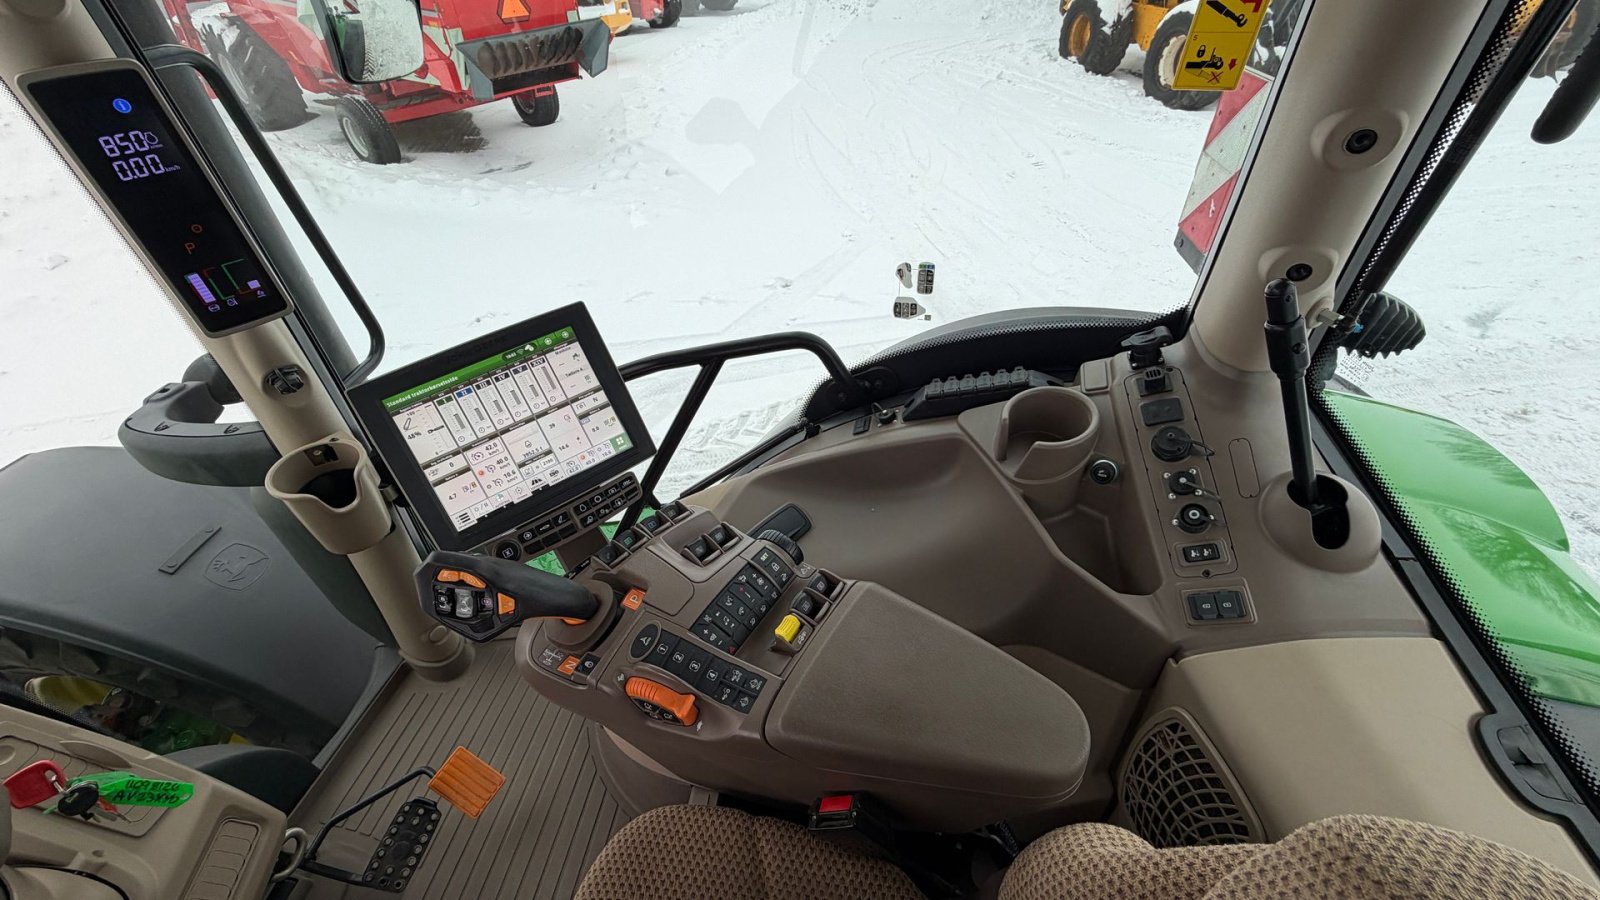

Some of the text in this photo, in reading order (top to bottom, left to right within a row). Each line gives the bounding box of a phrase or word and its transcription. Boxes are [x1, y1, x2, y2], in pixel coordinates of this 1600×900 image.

[98, 130, 150, 158] 850
[112, 154, 165, 182] 0.00
[387, 395, 411, 407] Standard
[760, 552, 769, 562] SET
[629, 594, 639, 604] P
